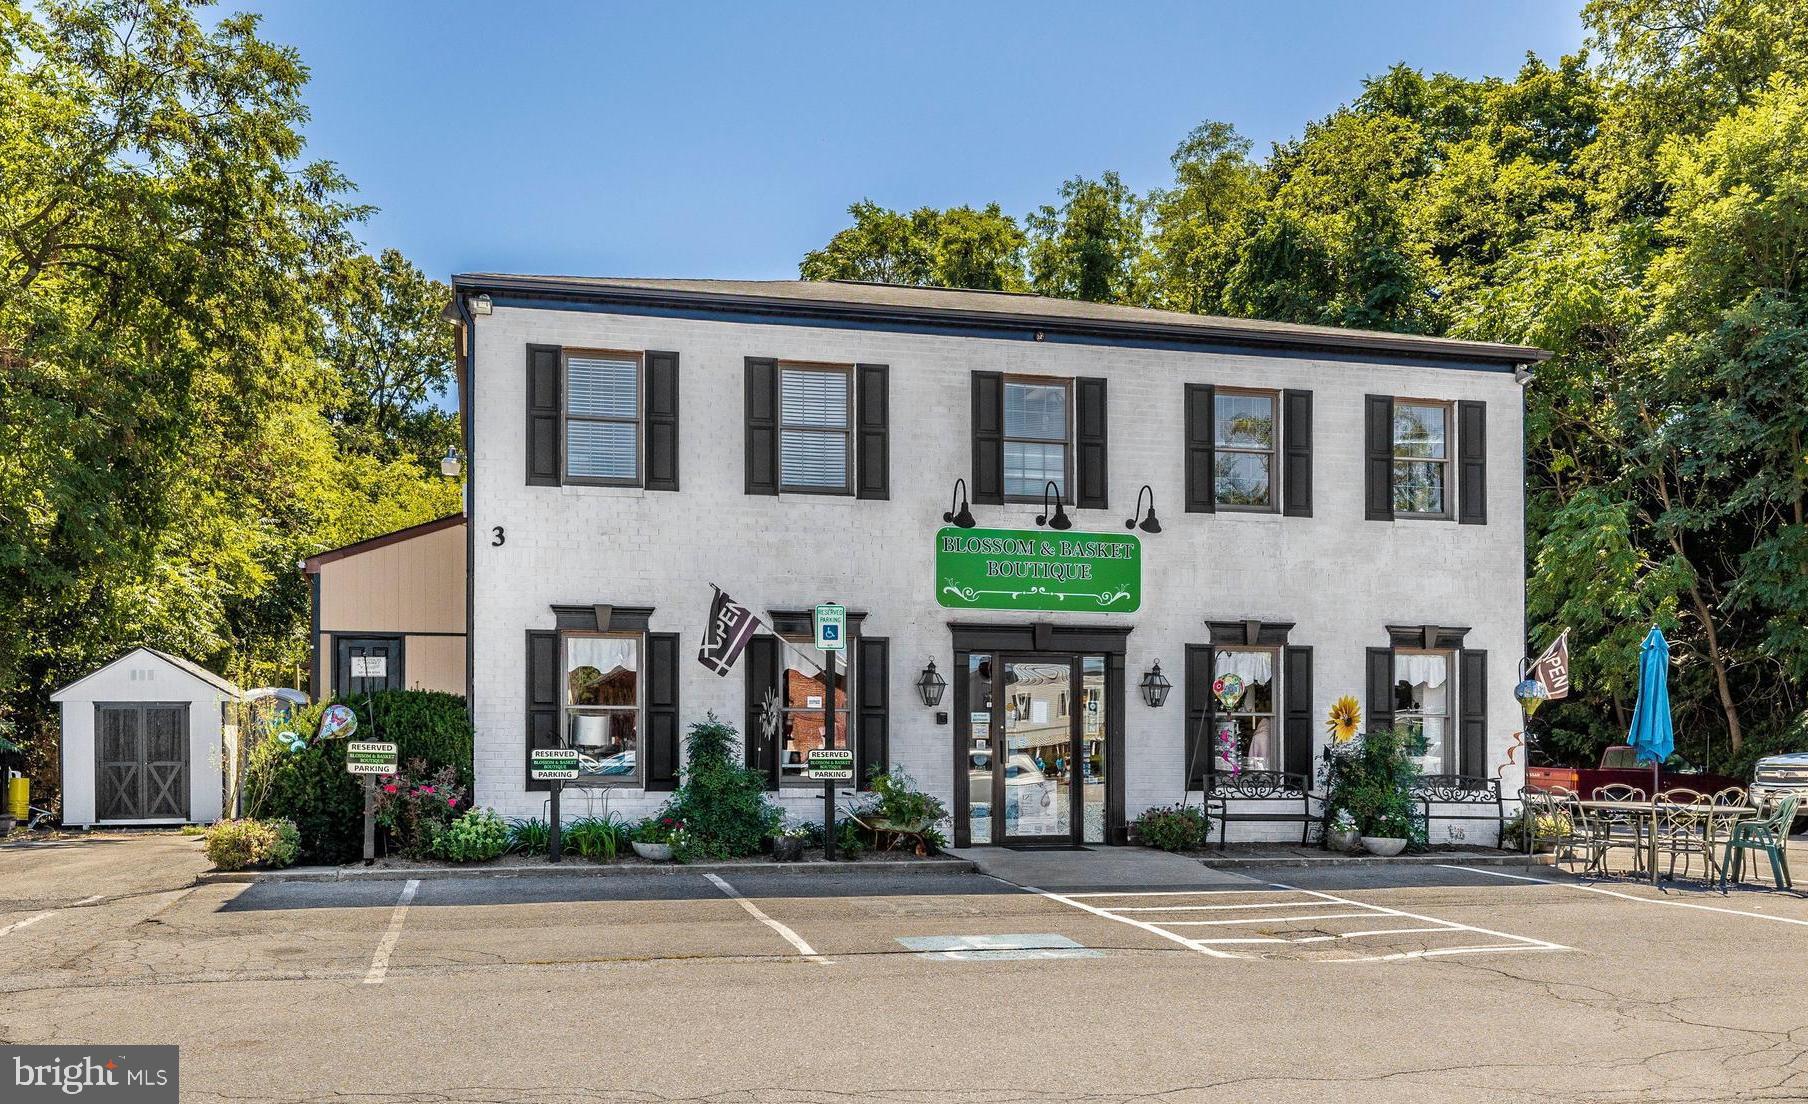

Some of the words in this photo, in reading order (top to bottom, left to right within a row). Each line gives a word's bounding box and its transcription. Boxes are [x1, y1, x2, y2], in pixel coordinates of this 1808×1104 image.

[491, 525, 506, 547] 3
[942, 536, 1035, 556] BLOSSOM
[1040, 541, 1055, 556] &
[1060, 540, 1134, 559] BASKET
[986, 560, 1092, 582] BOUTIQUE
[351, 743, 393, 752] RESERVED
